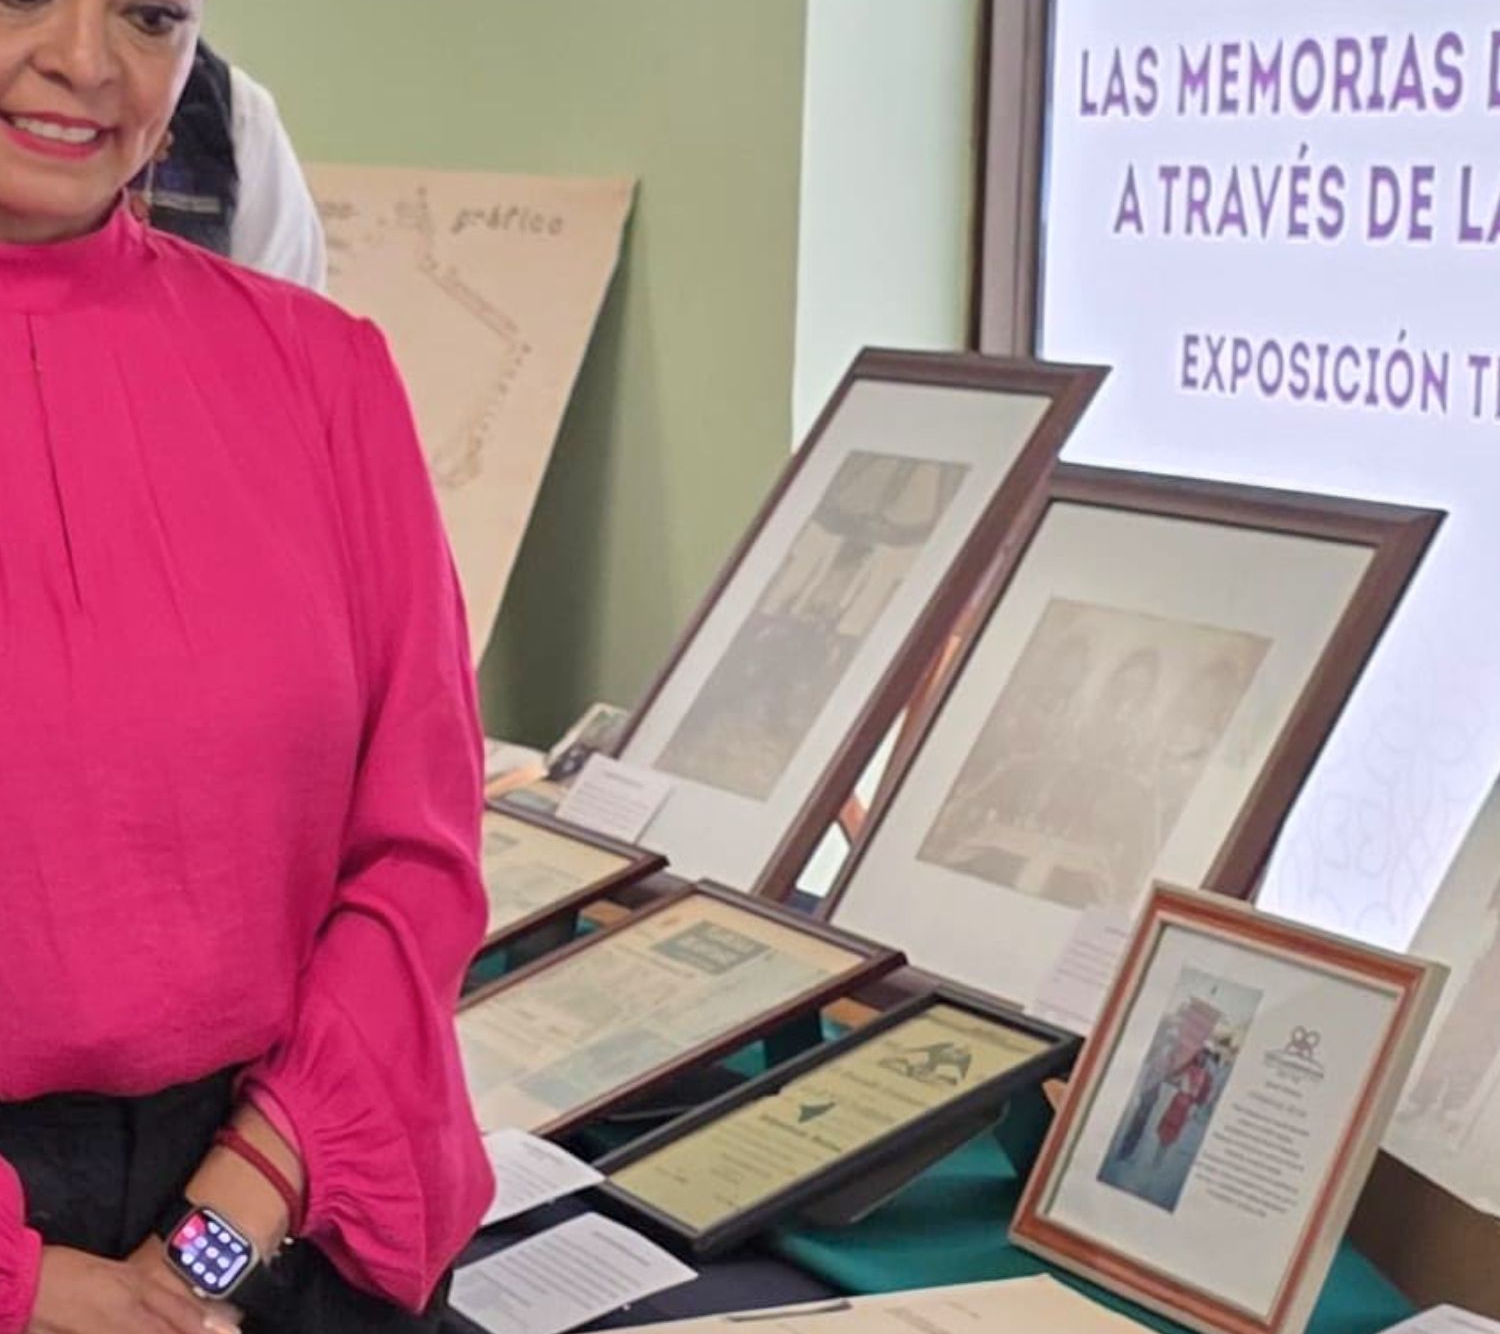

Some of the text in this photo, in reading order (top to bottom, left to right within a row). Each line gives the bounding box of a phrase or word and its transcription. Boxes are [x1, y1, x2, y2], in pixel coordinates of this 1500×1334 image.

[1079, 46, 1159, 118] LAS
[1176, 28, 1464, 116] MEMORIAS
[1113, 162, 1145, 236] A
[1158, 142, 1346, 242] TRAVÉS
[1366, 165, 1435, 243] DE
[1181, 330, 1449, 413] EXPOSICIÓN
